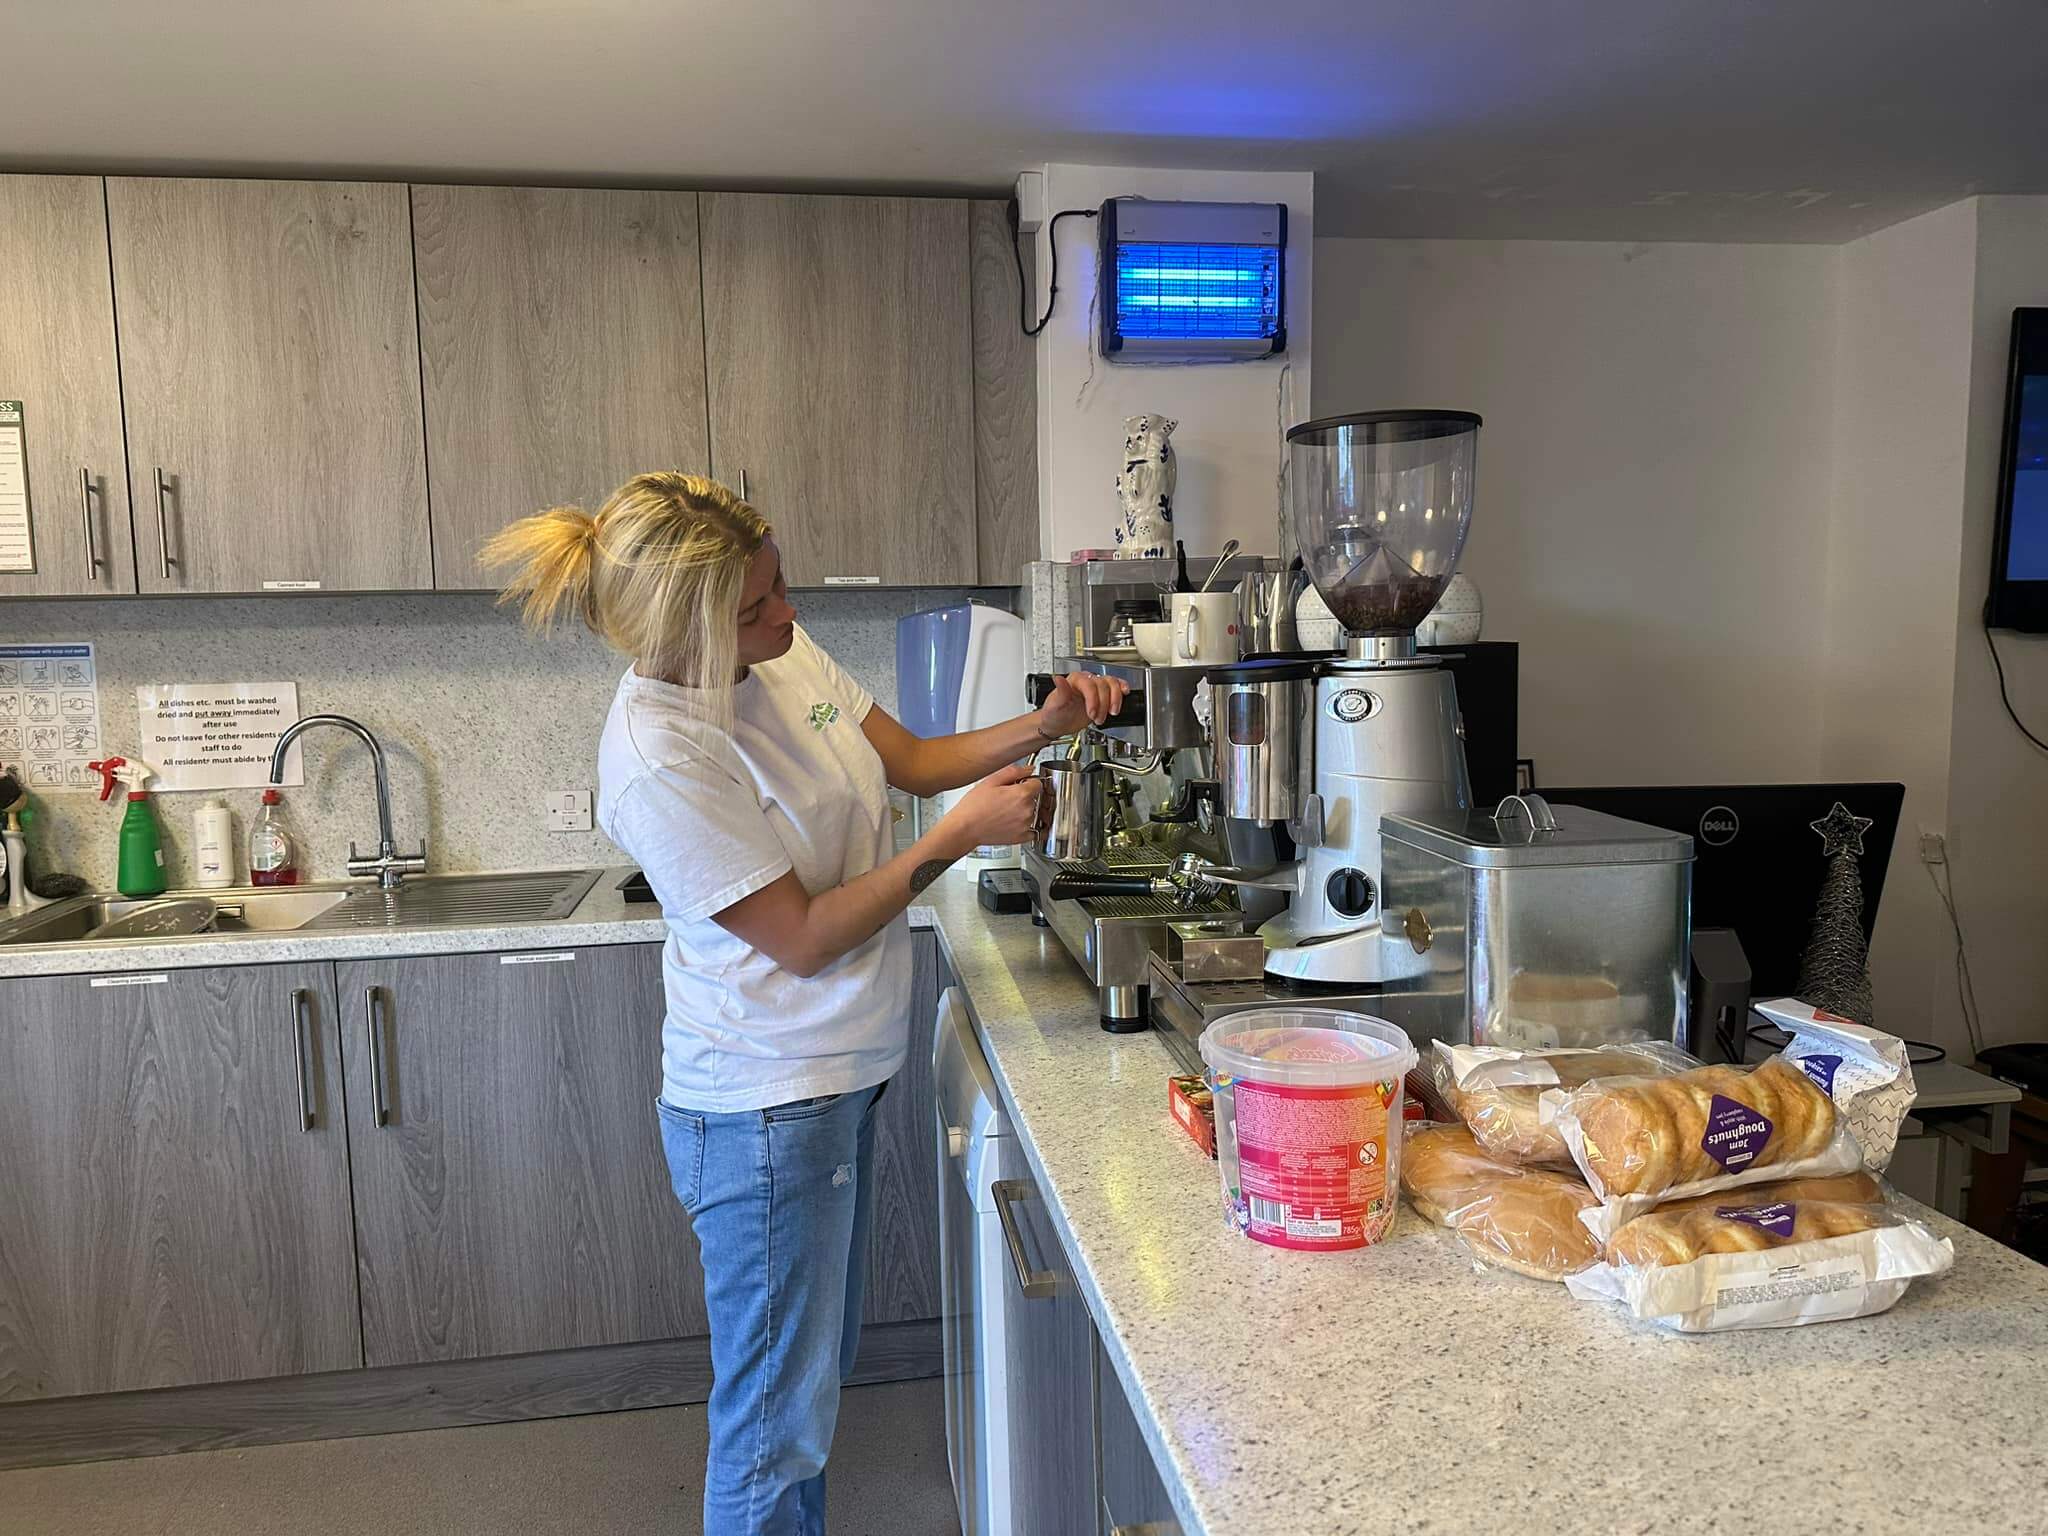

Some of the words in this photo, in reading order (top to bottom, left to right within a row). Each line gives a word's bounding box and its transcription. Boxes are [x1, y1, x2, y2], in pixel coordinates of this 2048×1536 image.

[248, 696, 277, 704] washed
[195, 711, 208, 719] put
[233, 708, 280, 717] immediately
[182, 734, 203, 742] leave
[241, 731, 276, 739] residents
[163, 758, 173, 766] All
[234, 755, 255, 763] abide
[257, 755, 266, 763] by
[1704, 821, 1734, 831] DELL
[1708, 1121, 1766, 1144] Doughnuts
[1729, 1138, 1749, 1150] Jam
